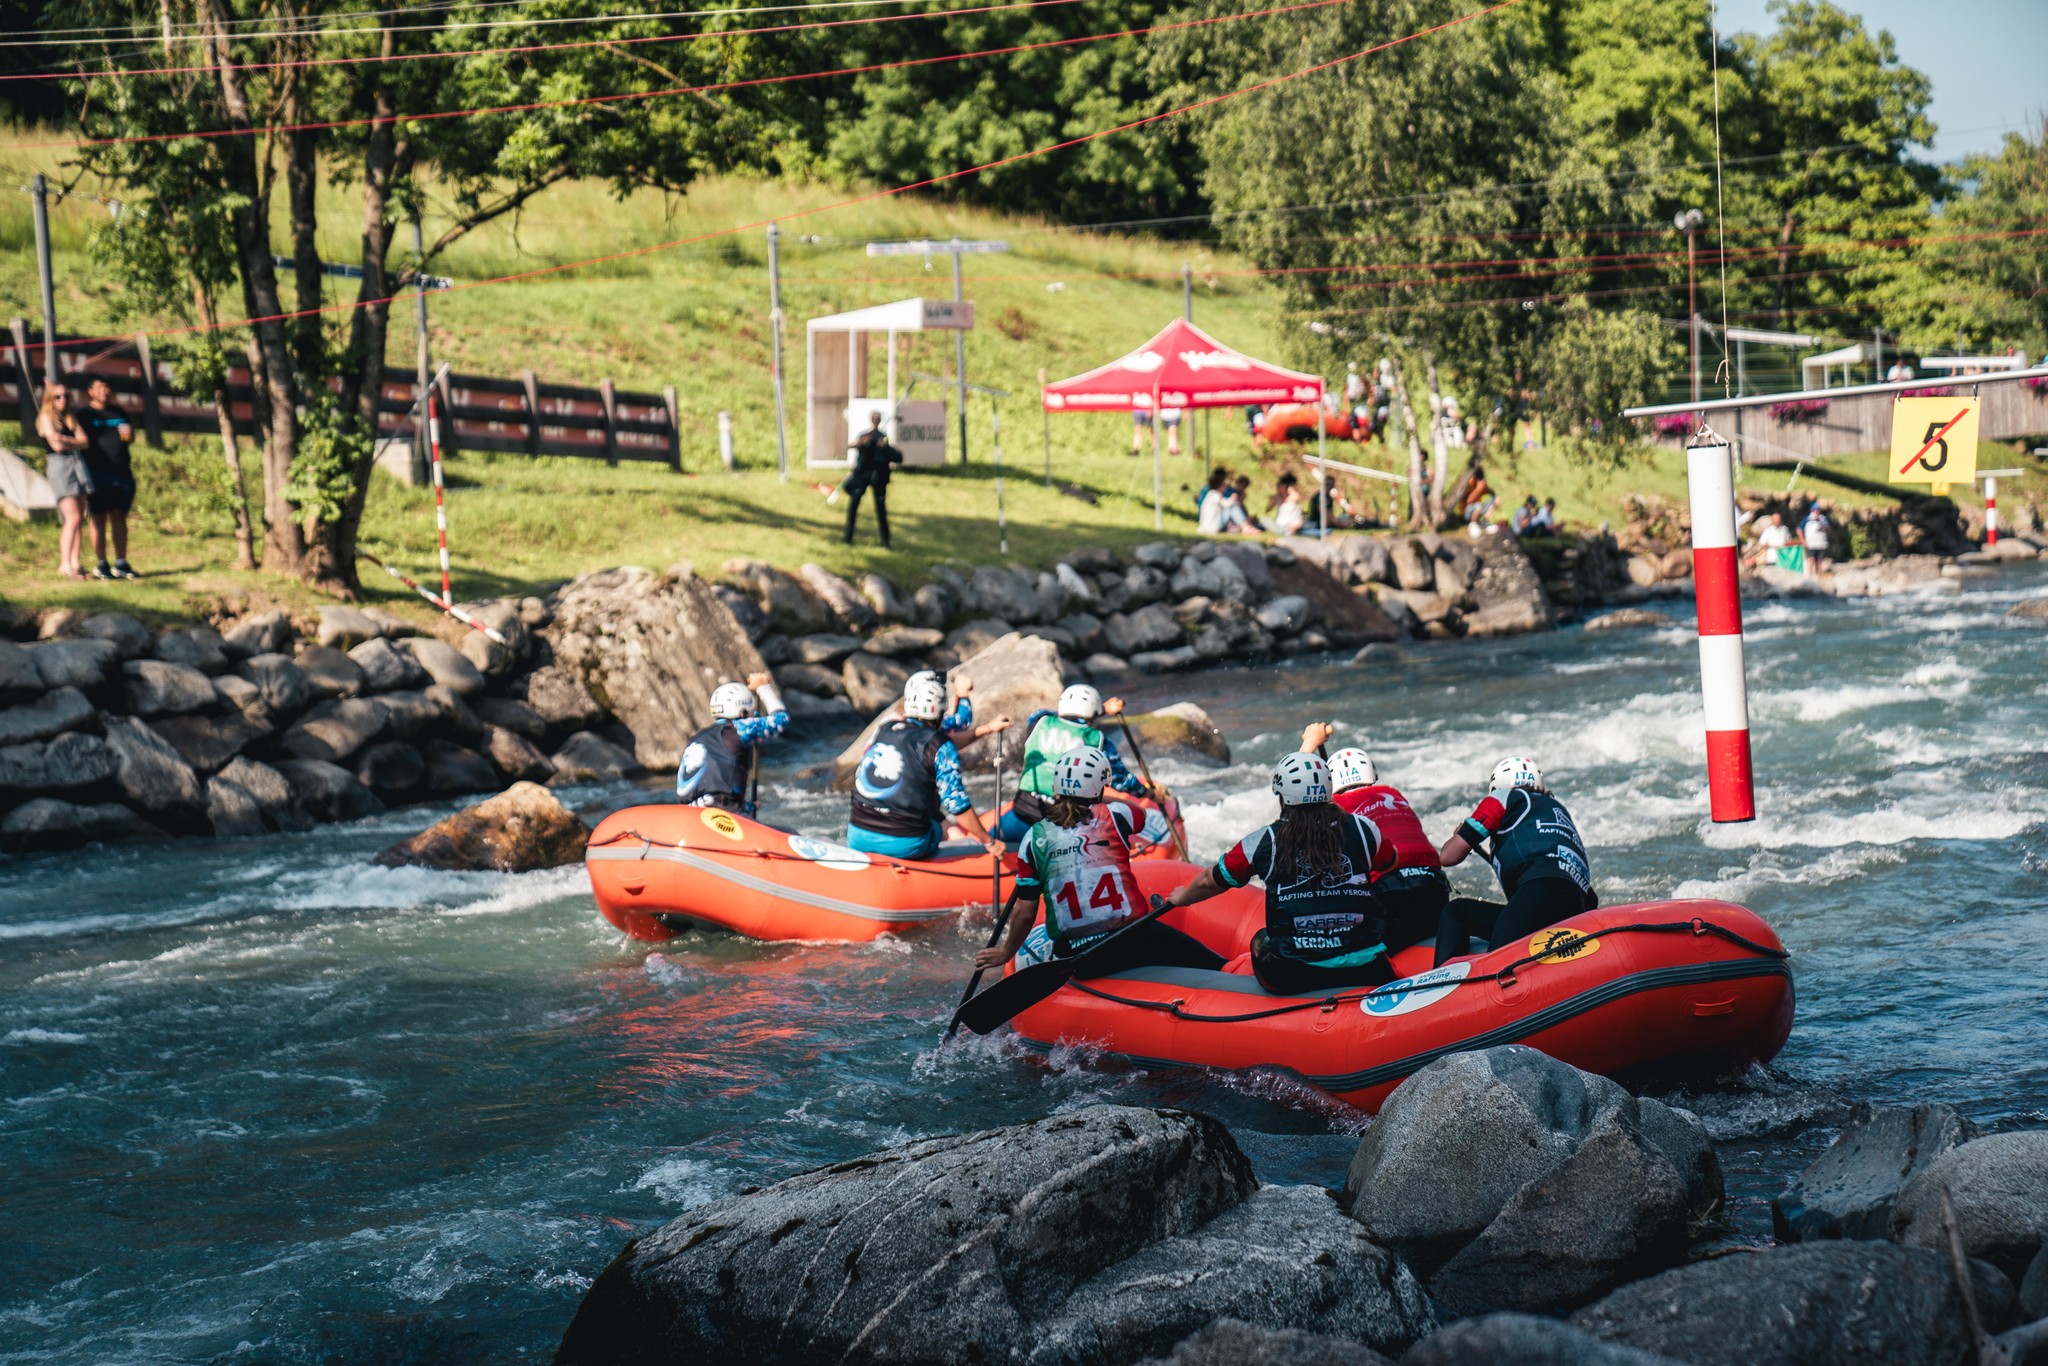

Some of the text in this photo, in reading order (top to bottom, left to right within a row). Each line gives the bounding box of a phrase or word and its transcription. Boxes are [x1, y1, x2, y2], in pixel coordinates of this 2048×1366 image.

[1920, 422, 1949, 472] 5
[1339, 767, 1359, 778] ITA
[1515, 771, 1535, 781] ITA
[1060, 778, 1082, 789] ITA
[1306, 785, 1327, 796] ITA
[1056, 873, 1125, 921] 14
[1278, 889, 1372, 902] RAFTING TEAM VERONA
[1293, 936, 1342, 949] VERONA
